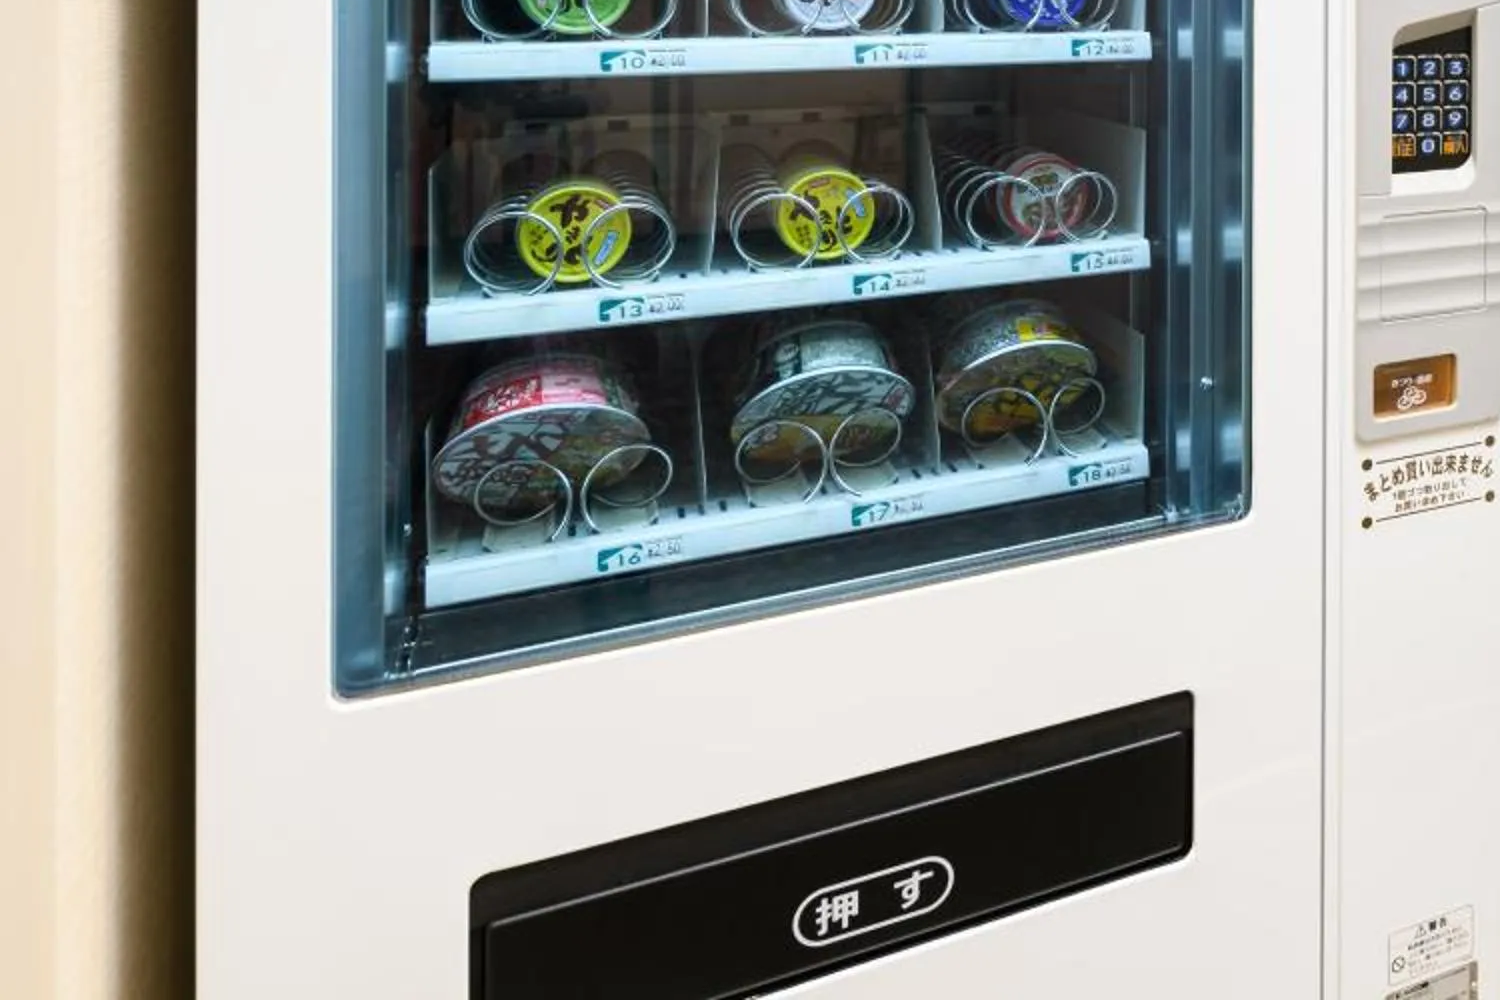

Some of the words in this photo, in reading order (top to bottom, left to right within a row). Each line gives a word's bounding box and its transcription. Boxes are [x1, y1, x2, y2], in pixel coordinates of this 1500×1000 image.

[873, 51, 890, 61] 11
[1086, 45, 1103, 56] 12
[620, 57, 645, 69] 10
[1396, 62, 1406, 76] 1
[1423, 62, 1436, 75] 2
[1450, 61, 1463, 75] 3
[1395, 87, 1408, 102] 4
[1423, 87, 1436, 101] 5
[1449, 86, 1462, 101] 6
[1395, 113, 1408, 129] 7
[1423, 113, 1435, 127] 8
[1449, 111, 1461, 125] 9
[1421, 138, 1435, 153] 0
[1086, 258, 1104, 271] 15
[870, 281, 890, 293] 14
[620, 304, 643, 319] 13
[1083, 470, 1102, 482] 18
[1363, 453, 1496, 503] まとめ買い出来ません
[868, 504, 890, 522] 17
[618, 551, 641, 566] 16
[815, 869, 934, 936] 押す
